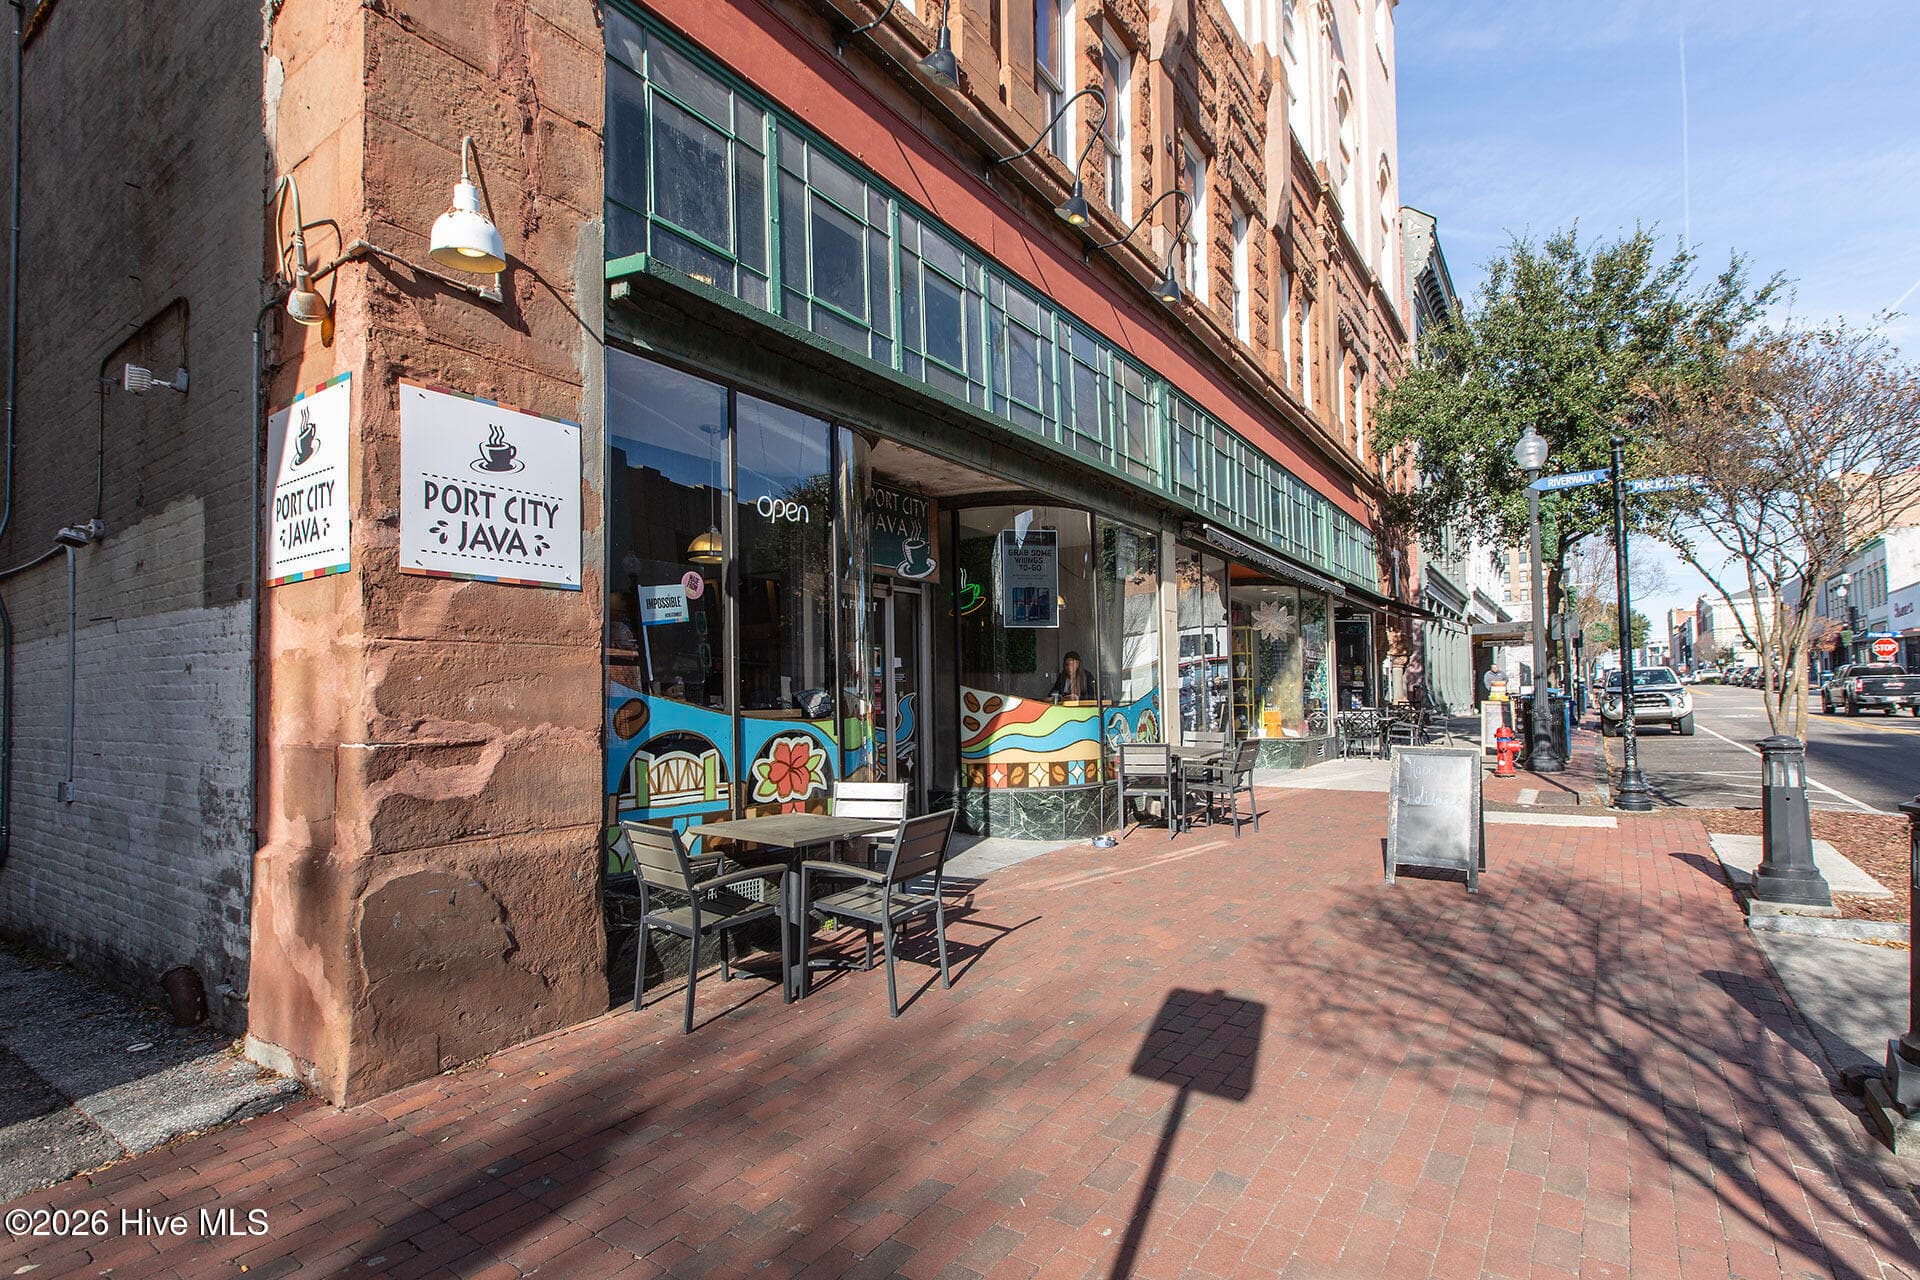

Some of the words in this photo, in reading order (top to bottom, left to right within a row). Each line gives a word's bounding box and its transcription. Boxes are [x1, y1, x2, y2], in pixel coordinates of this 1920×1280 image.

[1547, 473, 1595, 488] RIVERWALK
[276, 489, 304, 522] PORT
[307, 479, 335, 512] CITY
[424, 480, 496, 519] PORT
[504, 496, 559, 529] CITY
[757, 495, 809, 524] Open
[903, 497, 928, 519] CITY
[288, 516, 320, 550] JAVA
[458, 521, 528, 557] JAVA
[646, 595, 682, 610] IMPOSSIBLE
[1874, 643, 1896, 652] STOP
